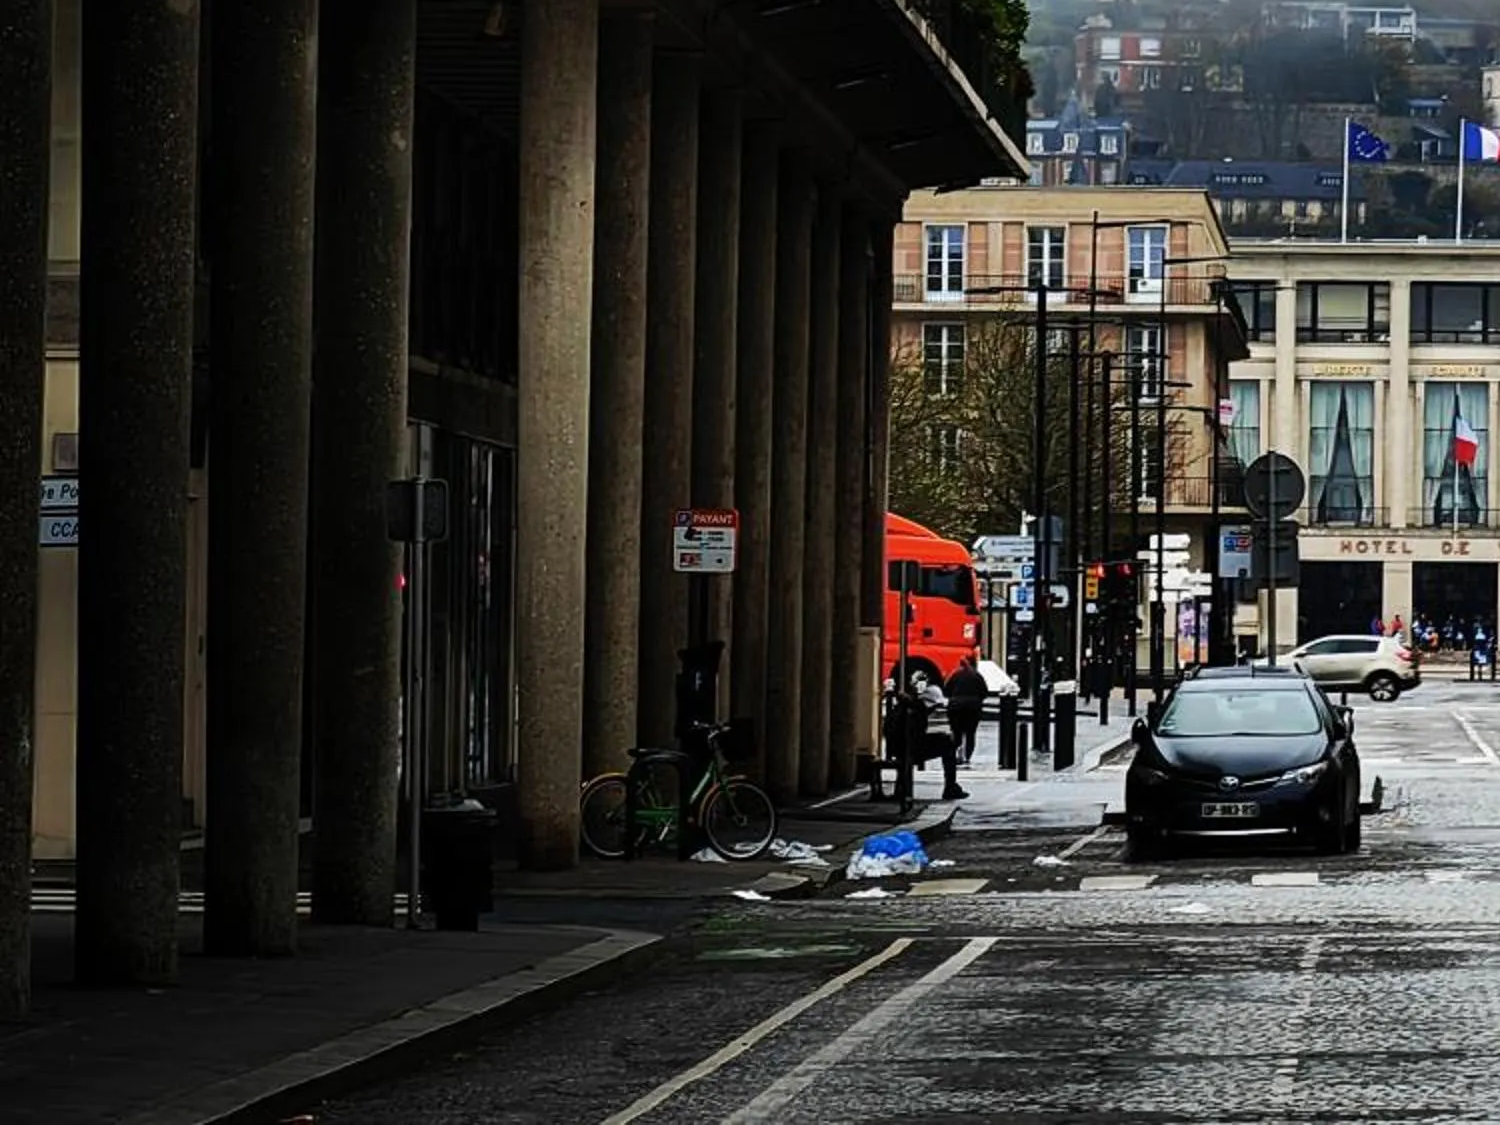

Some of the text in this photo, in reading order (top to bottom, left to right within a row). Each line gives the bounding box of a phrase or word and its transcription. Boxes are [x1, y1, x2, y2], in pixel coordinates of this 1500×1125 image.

[693, 514, 732, 525] PAYANT
[1339, 540, 1413, 554] HOTEL
[1440, 541, 1471, 555] DE
